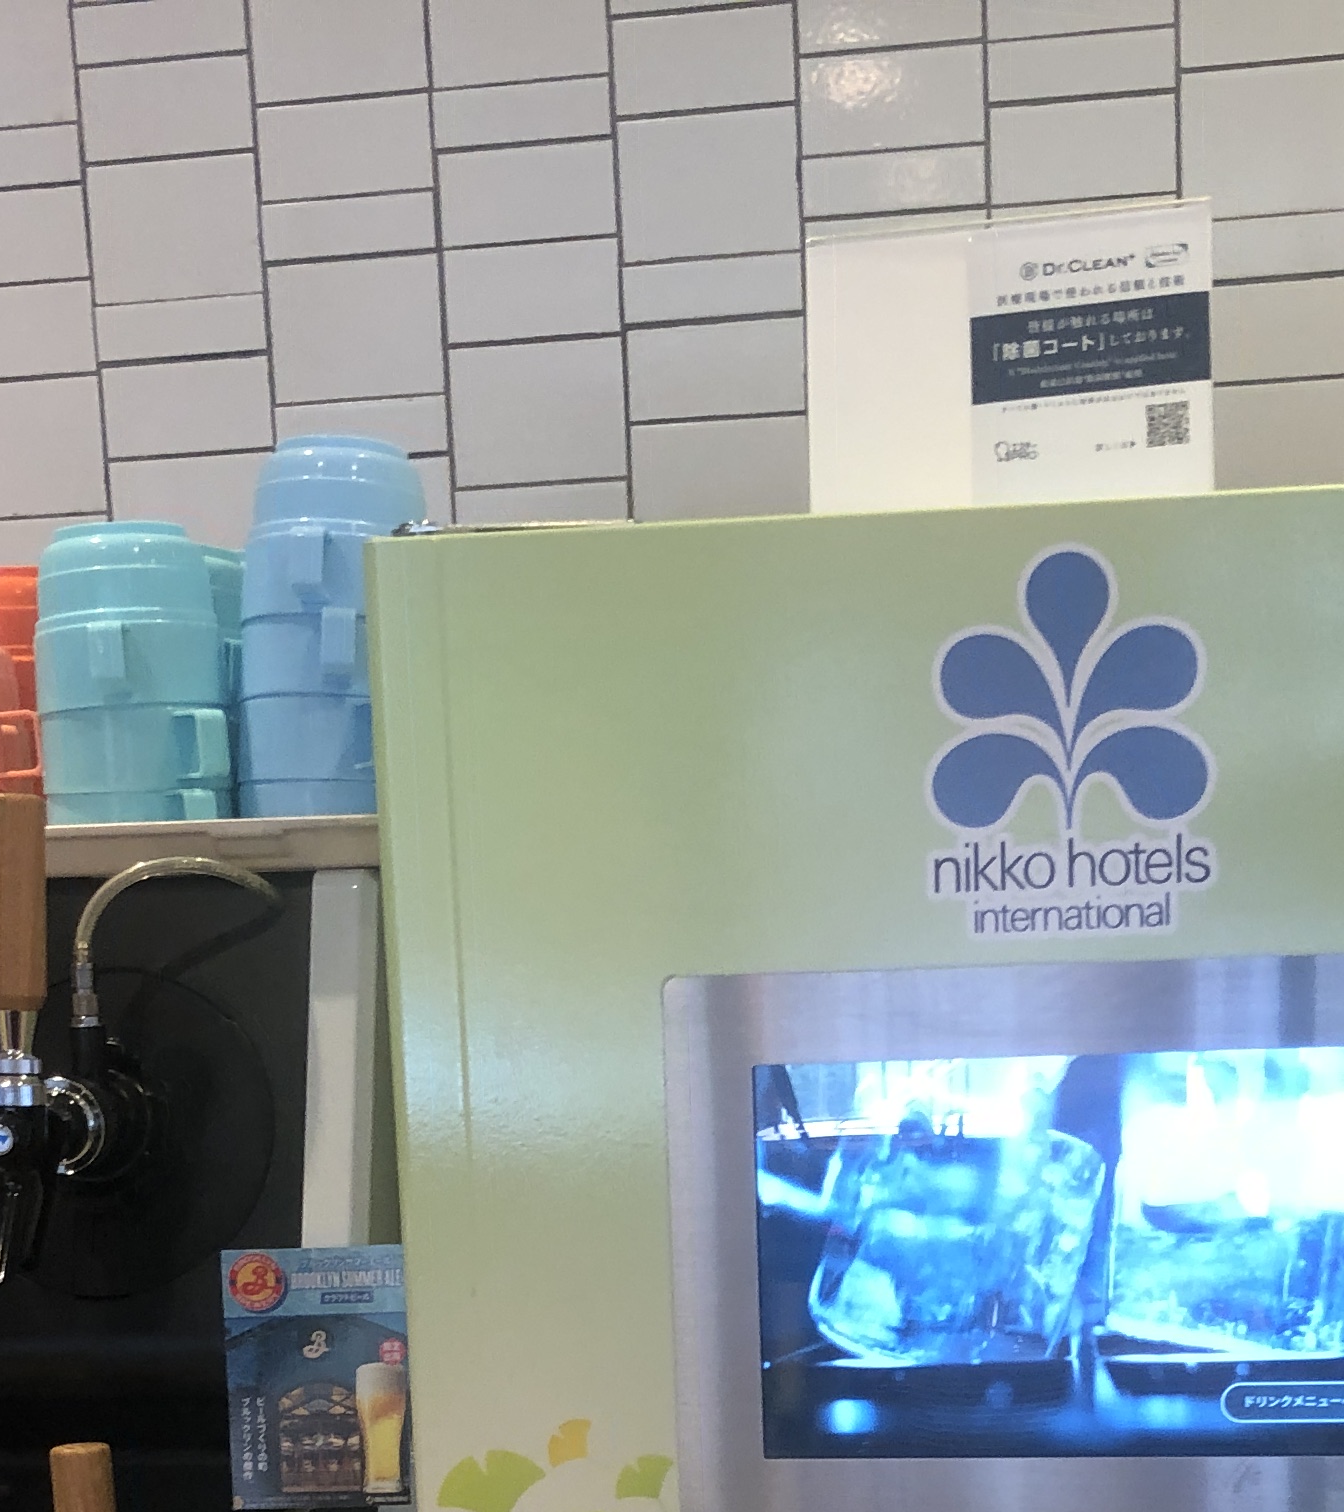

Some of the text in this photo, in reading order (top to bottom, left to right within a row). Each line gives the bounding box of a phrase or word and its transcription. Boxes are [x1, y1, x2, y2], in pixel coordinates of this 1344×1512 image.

[933, 833, 1211, 893] nikko hotels
[973, 891, 1171, 934] international
